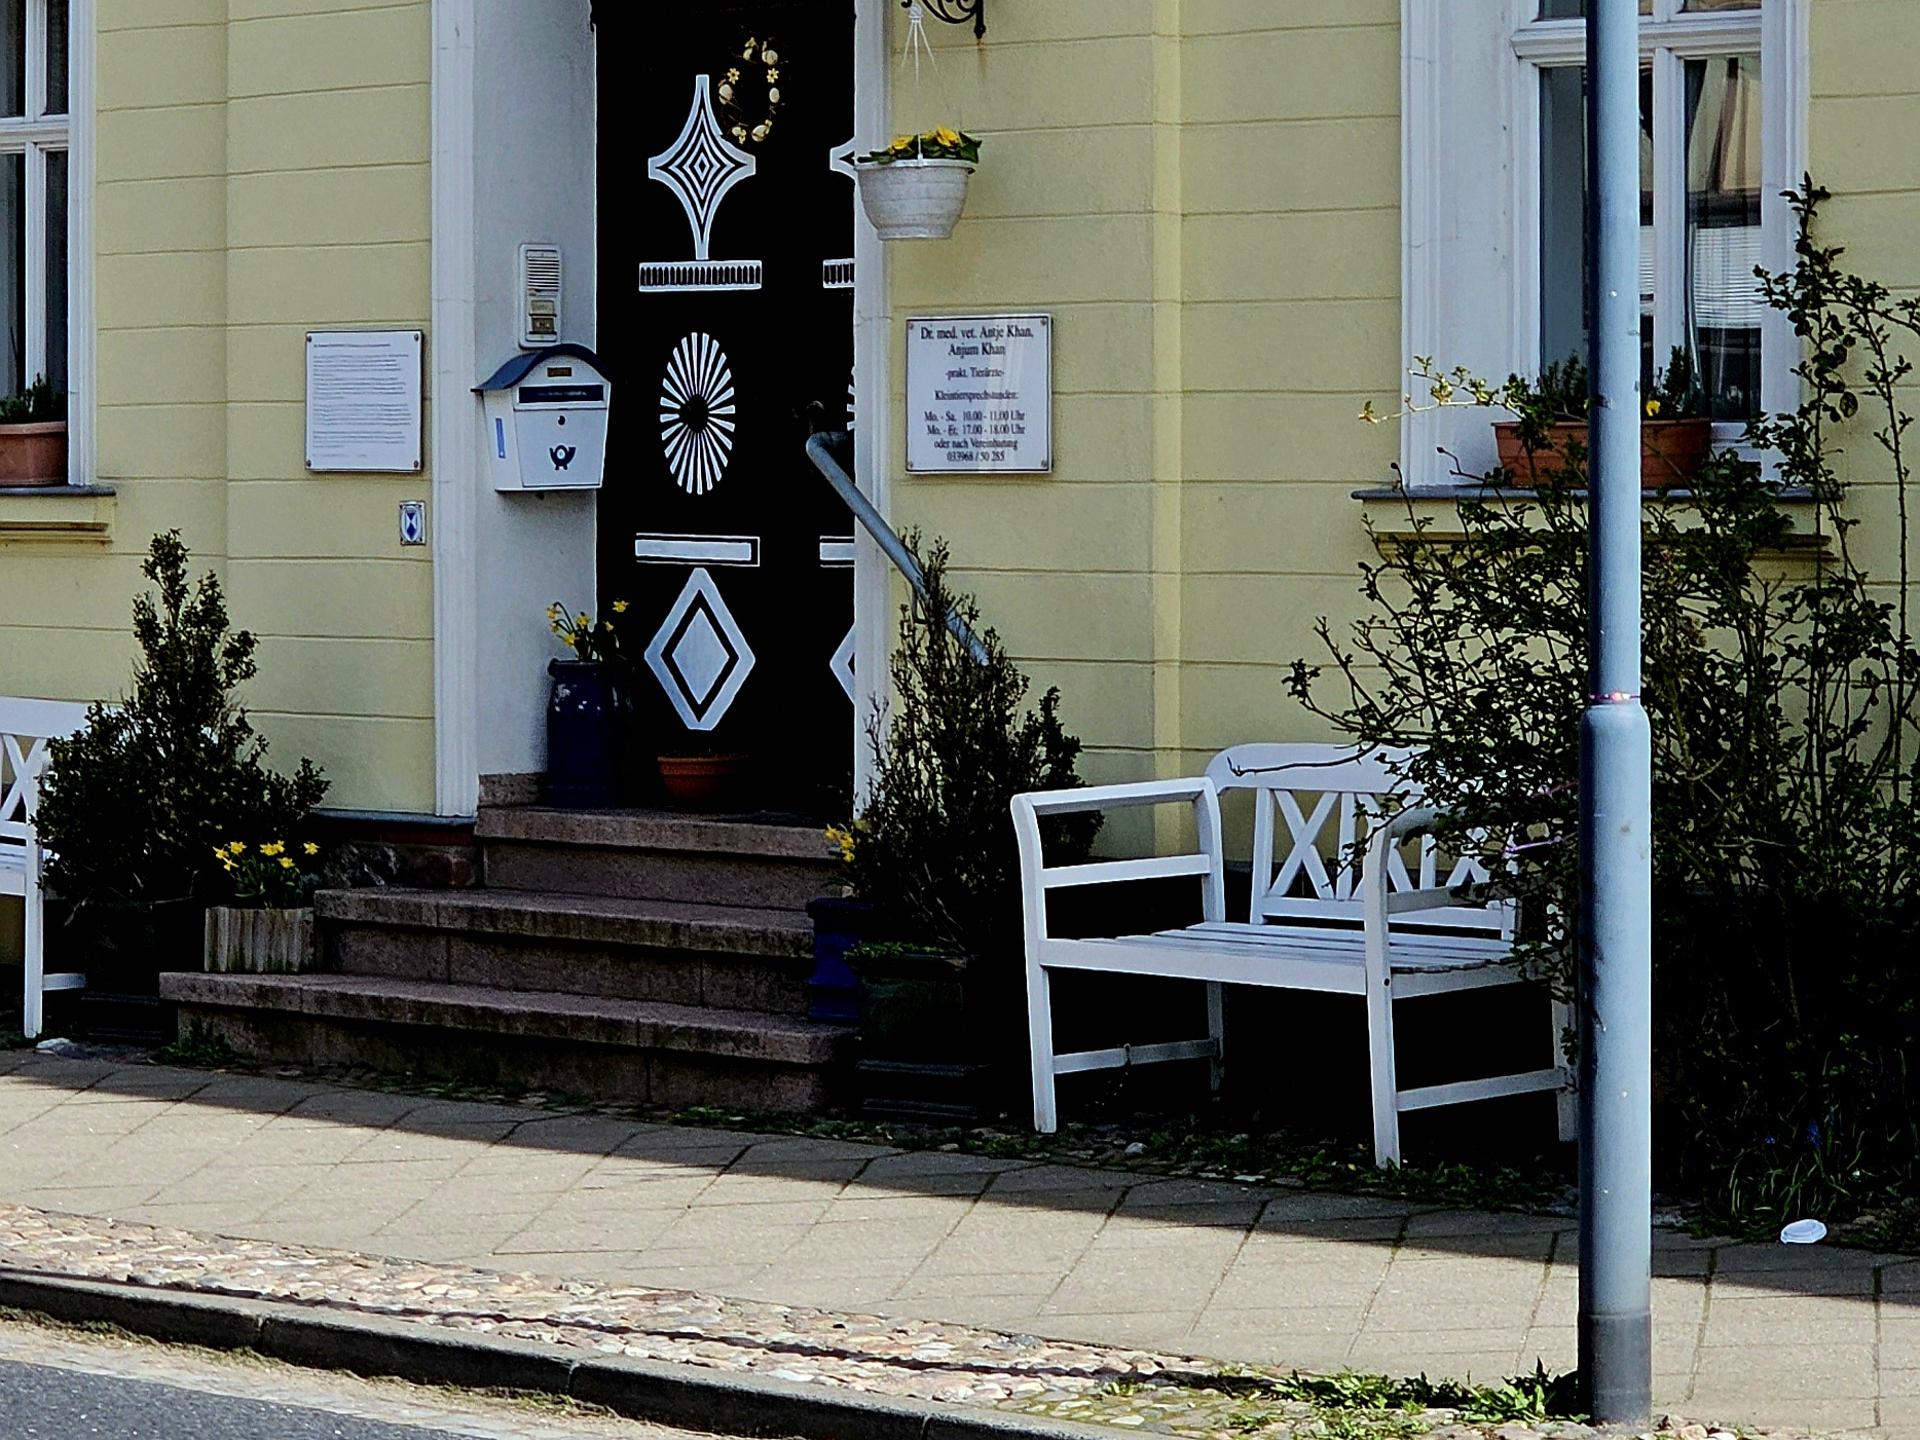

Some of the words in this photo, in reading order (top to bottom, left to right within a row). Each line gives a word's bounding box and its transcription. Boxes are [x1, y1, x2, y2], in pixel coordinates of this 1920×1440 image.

[921, 326, 934, 339] Dr.
[937, 326, 957, 339] med.
[961, 328, 977, 339] vet.
[980, 325, 1004, 341] Antje
[981, 342, 1006, 356] Khan
[924, 411, 938, 421] Mo.
[962, 411, 983, 421] 10.00
[1011, 410, 1025, 421] Uhr
[927, 425, 942, 435] Mo.
[962, 425, 983, 434] 17.00
[1011, 424, 1025, 435] Uhr
[934, 439, 949, 448] oder
[952, 439, 968, 448] nach
